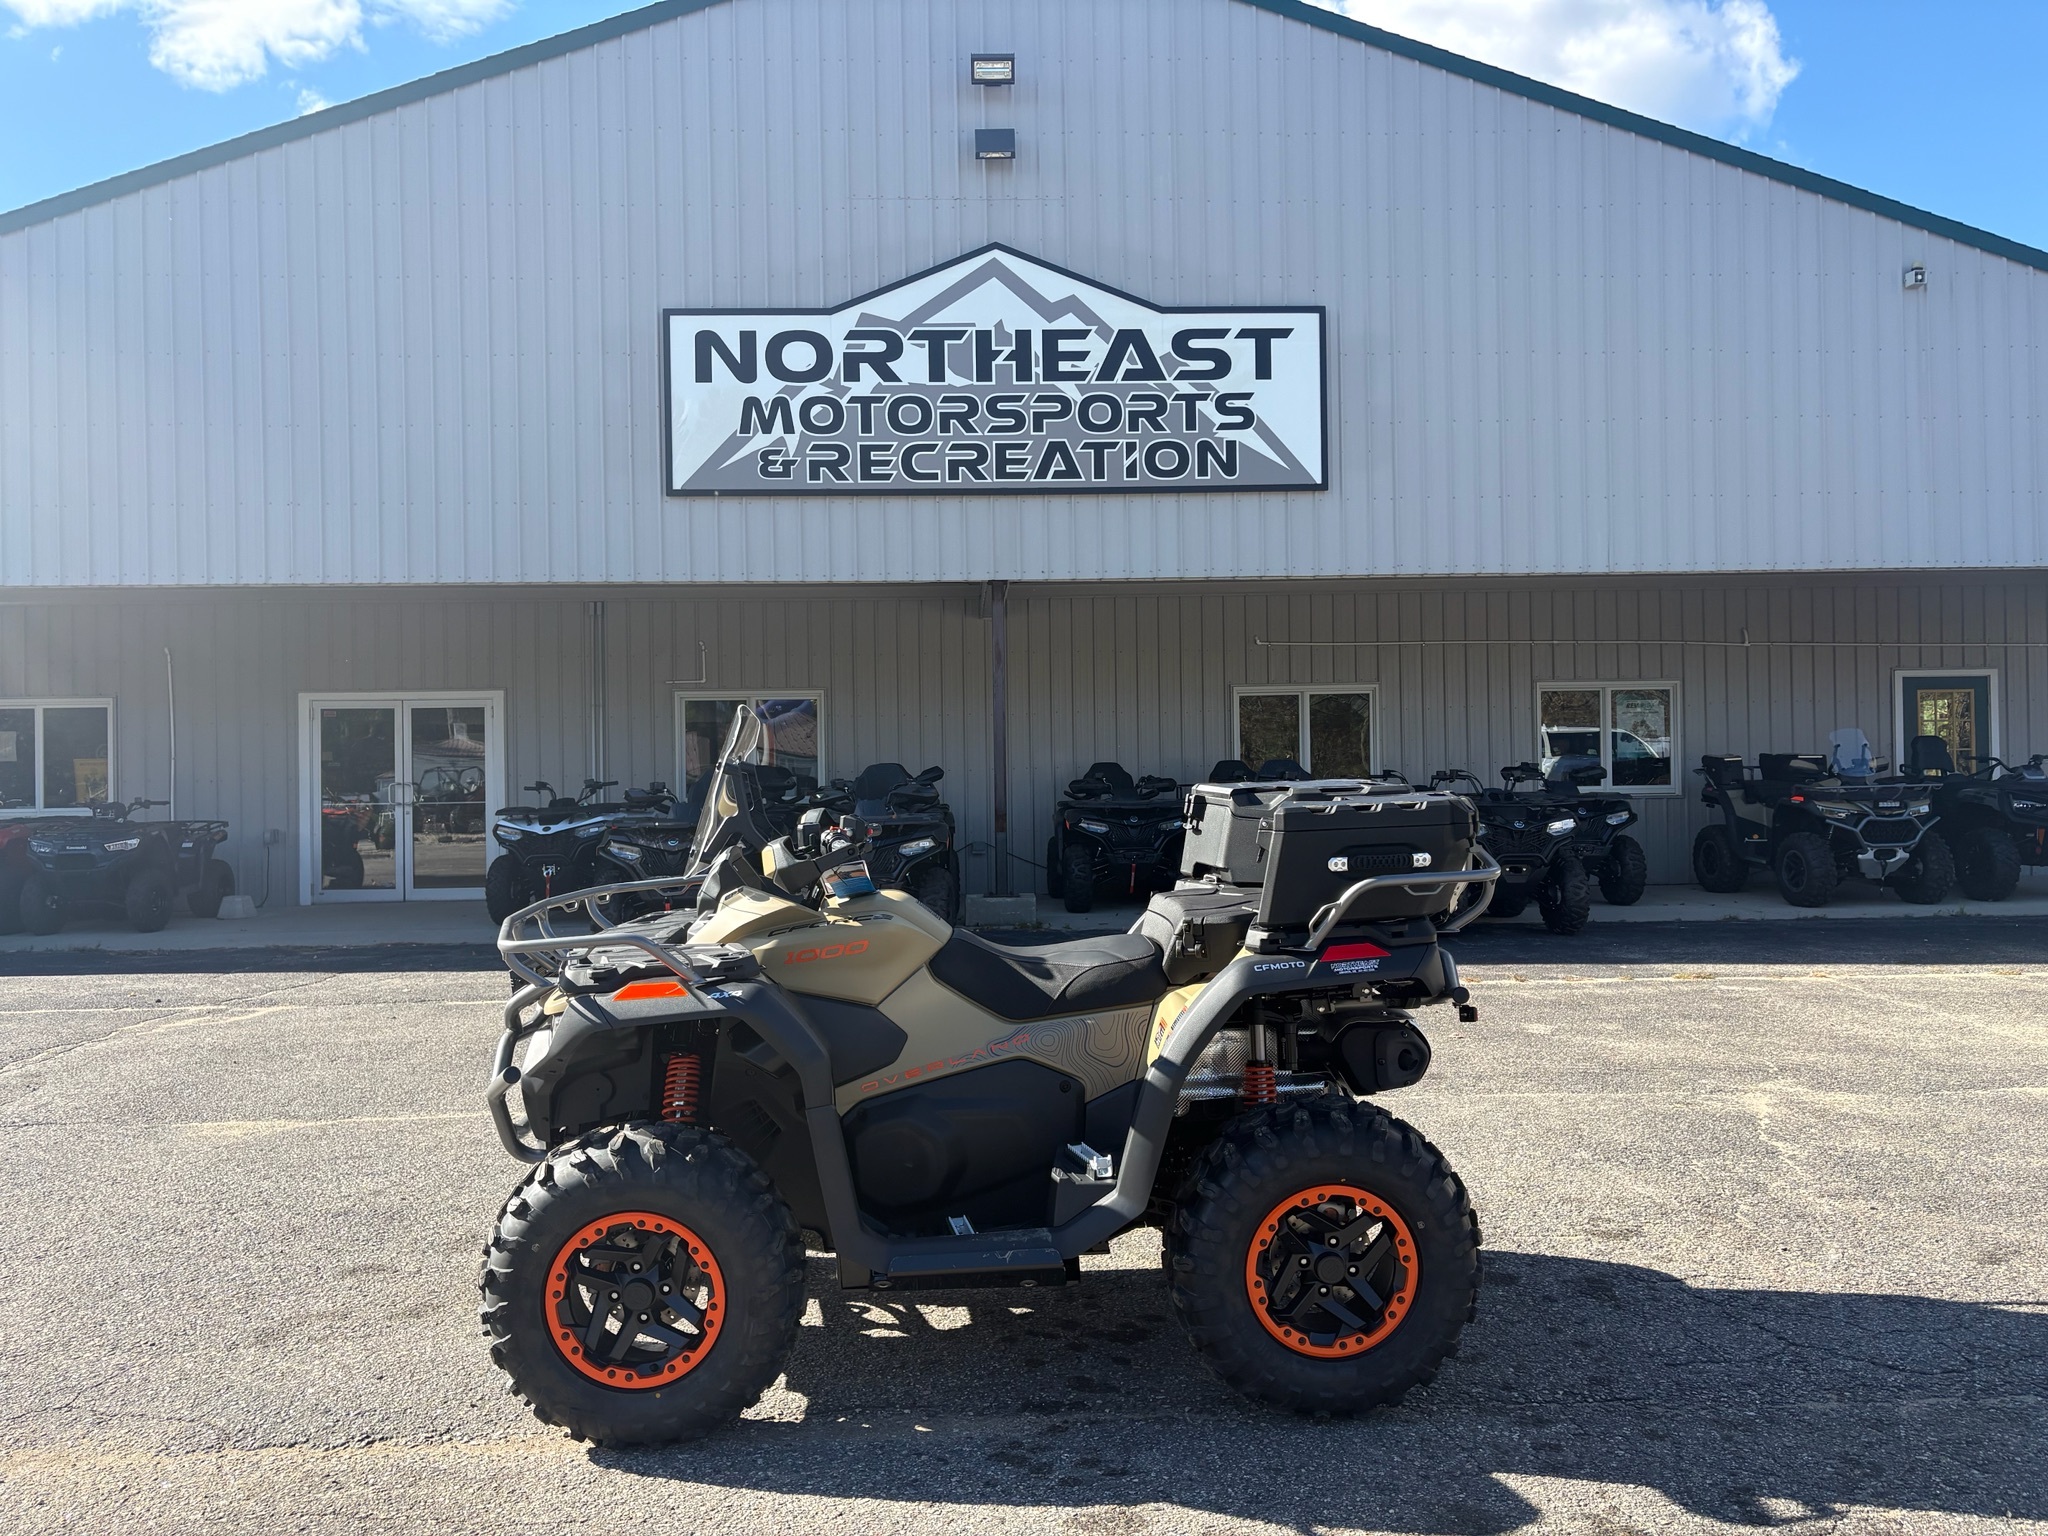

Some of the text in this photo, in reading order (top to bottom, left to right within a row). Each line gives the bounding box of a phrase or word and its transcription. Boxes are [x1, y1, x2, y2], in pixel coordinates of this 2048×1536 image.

[694, 327, 1294, 384] NORTHEAST
[737, 391, 1257, 436] MOTORSPORTS
[784, 939, 870, 965] 1000
[1253, 961, 1306, 972] CFMOTO
[860, 1033, 1030, 1093] OVERLAND
